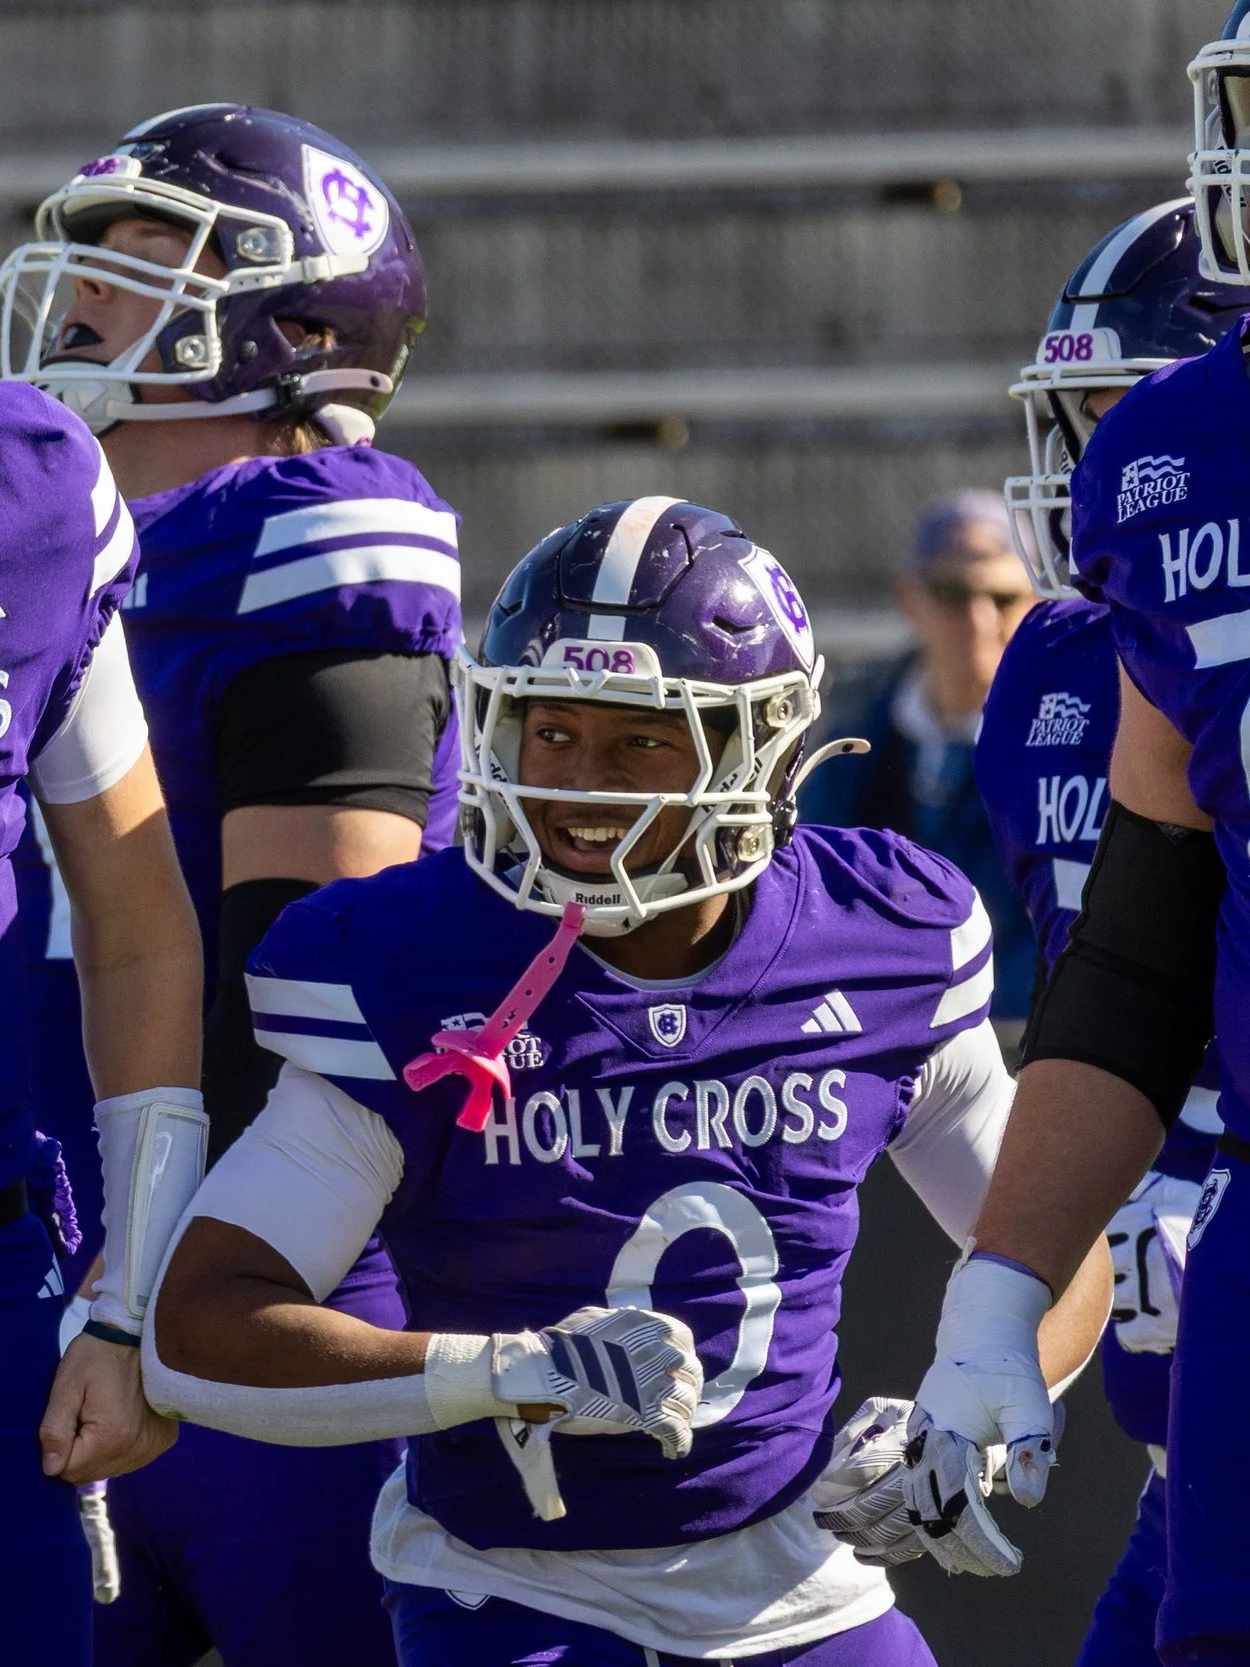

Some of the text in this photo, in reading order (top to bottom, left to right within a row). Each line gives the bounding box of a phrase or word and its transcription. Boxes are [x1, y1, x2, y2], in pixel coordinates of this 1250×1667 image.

[1044, 332, 1093, 364] 508
[1117, 472, 1191, 509] PATRIOT
[1117, 487, 1188, 524] LEAGUE
[1158, 518, 1250, 603] HOL
[562, 645, 635, 675] 508
[1025, 731, 1084, 747] LEAGUE
[1030, 716, 1091, 733] PATRIOT
[1035, 774, 1107, 845] HOL
[575, 892, 621, 905] Riddell
[485, 1068, 848, 1166] HOLY CROSS
[607, 1181, 782, 1429] 0
